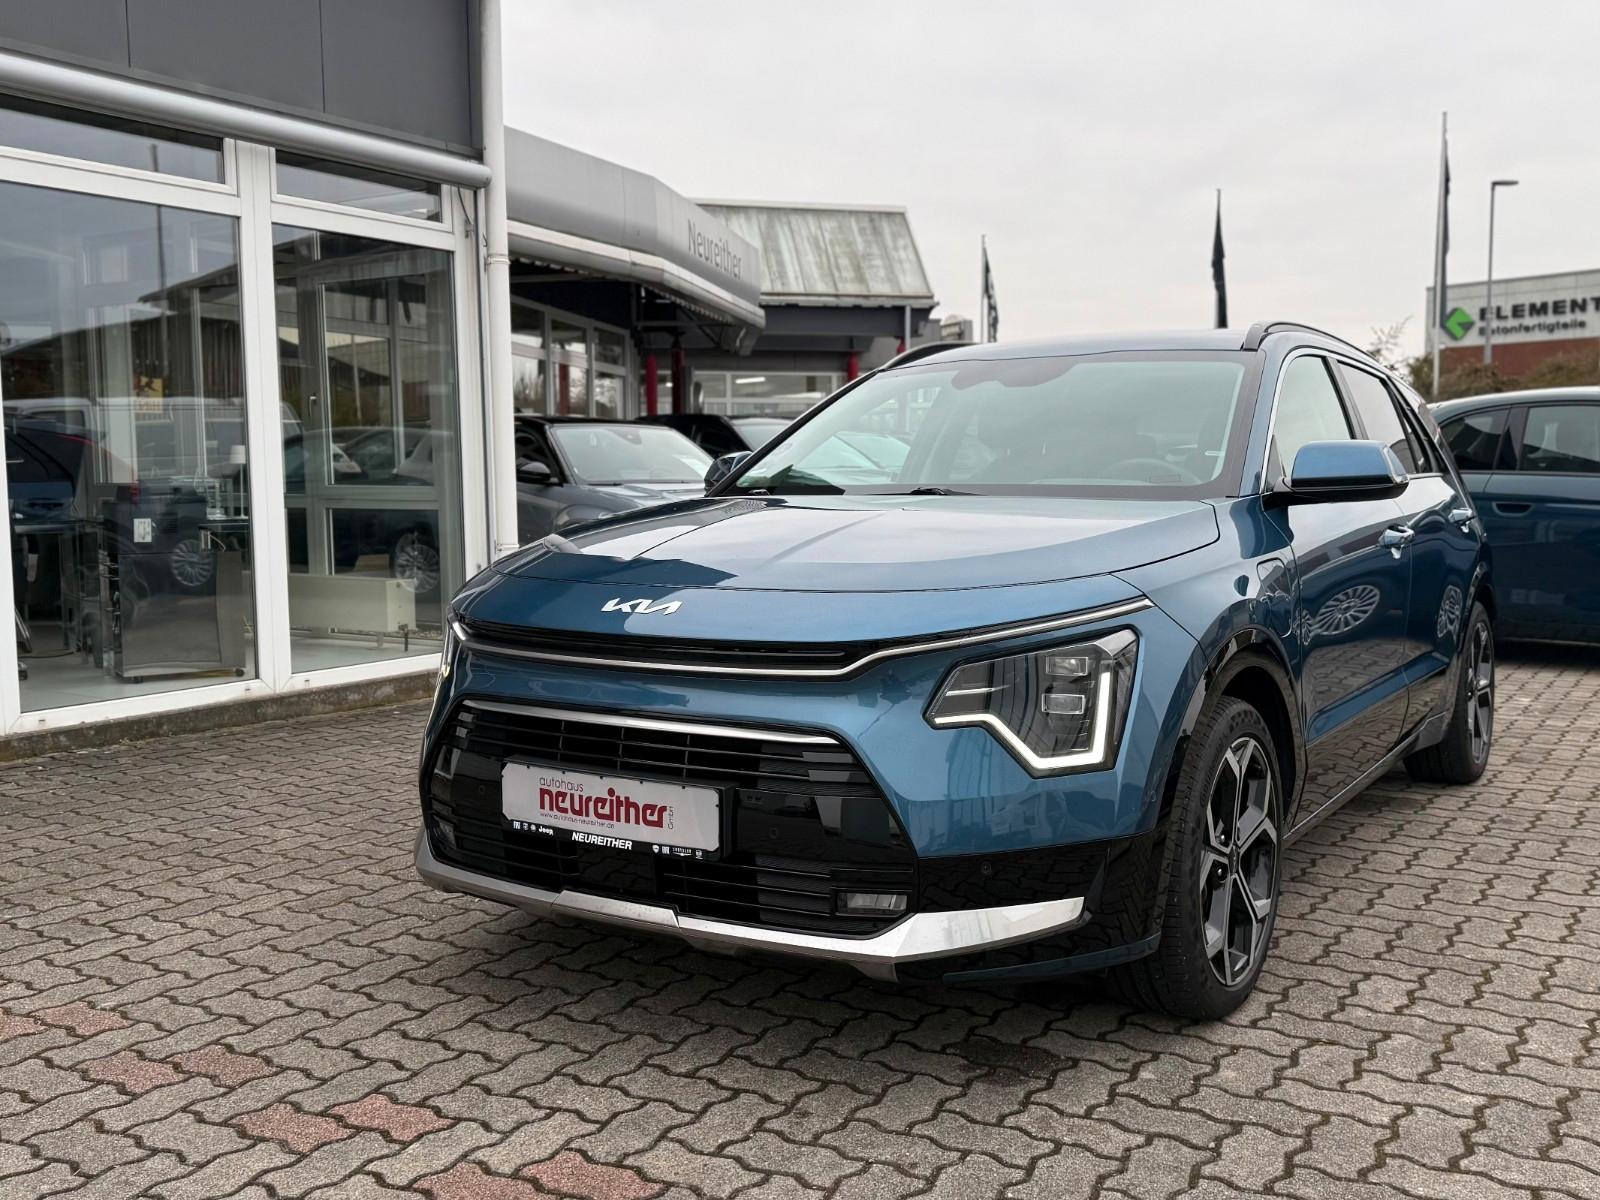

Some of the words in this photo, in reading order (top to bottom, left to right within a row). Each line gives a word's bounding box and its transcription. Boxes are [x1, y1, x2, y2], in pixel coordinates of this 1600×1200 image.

[687, 218, 742, 280] Neureither
[601, 598, 683, 616] KIA
[539, 776, 584, 793] autohaus
[539, 787, 668, 829] neureither
[571, 832, 633, 850] NEUREITHER
